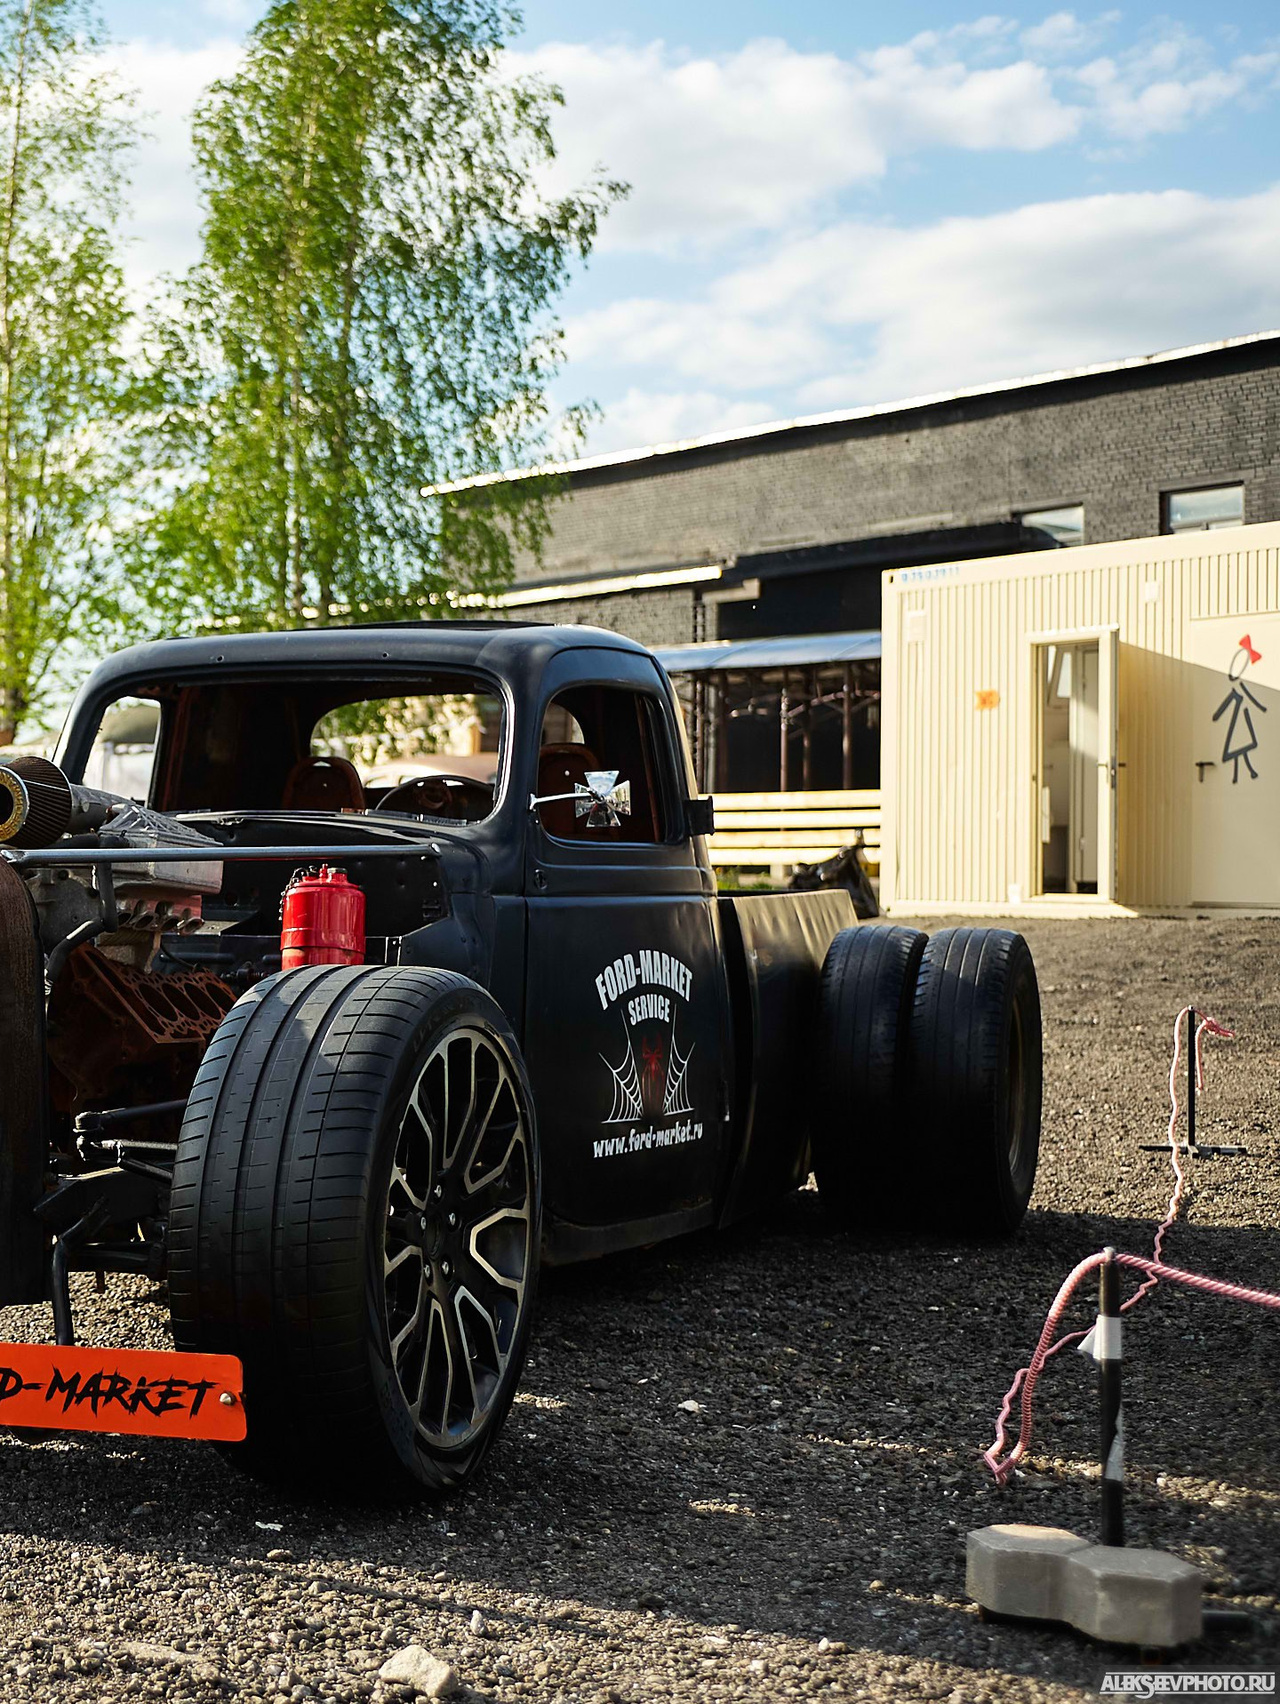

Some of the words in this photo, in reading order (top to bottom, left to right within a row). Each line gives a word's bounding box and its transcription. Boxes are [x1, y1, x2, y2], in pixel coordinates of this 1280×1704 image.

[595, 949, 693, 1011] FORD-MARKET
[628, 993, 670, 1026] SERVICE
[593, 1119, 703, 1158] www.ford-market.ru
